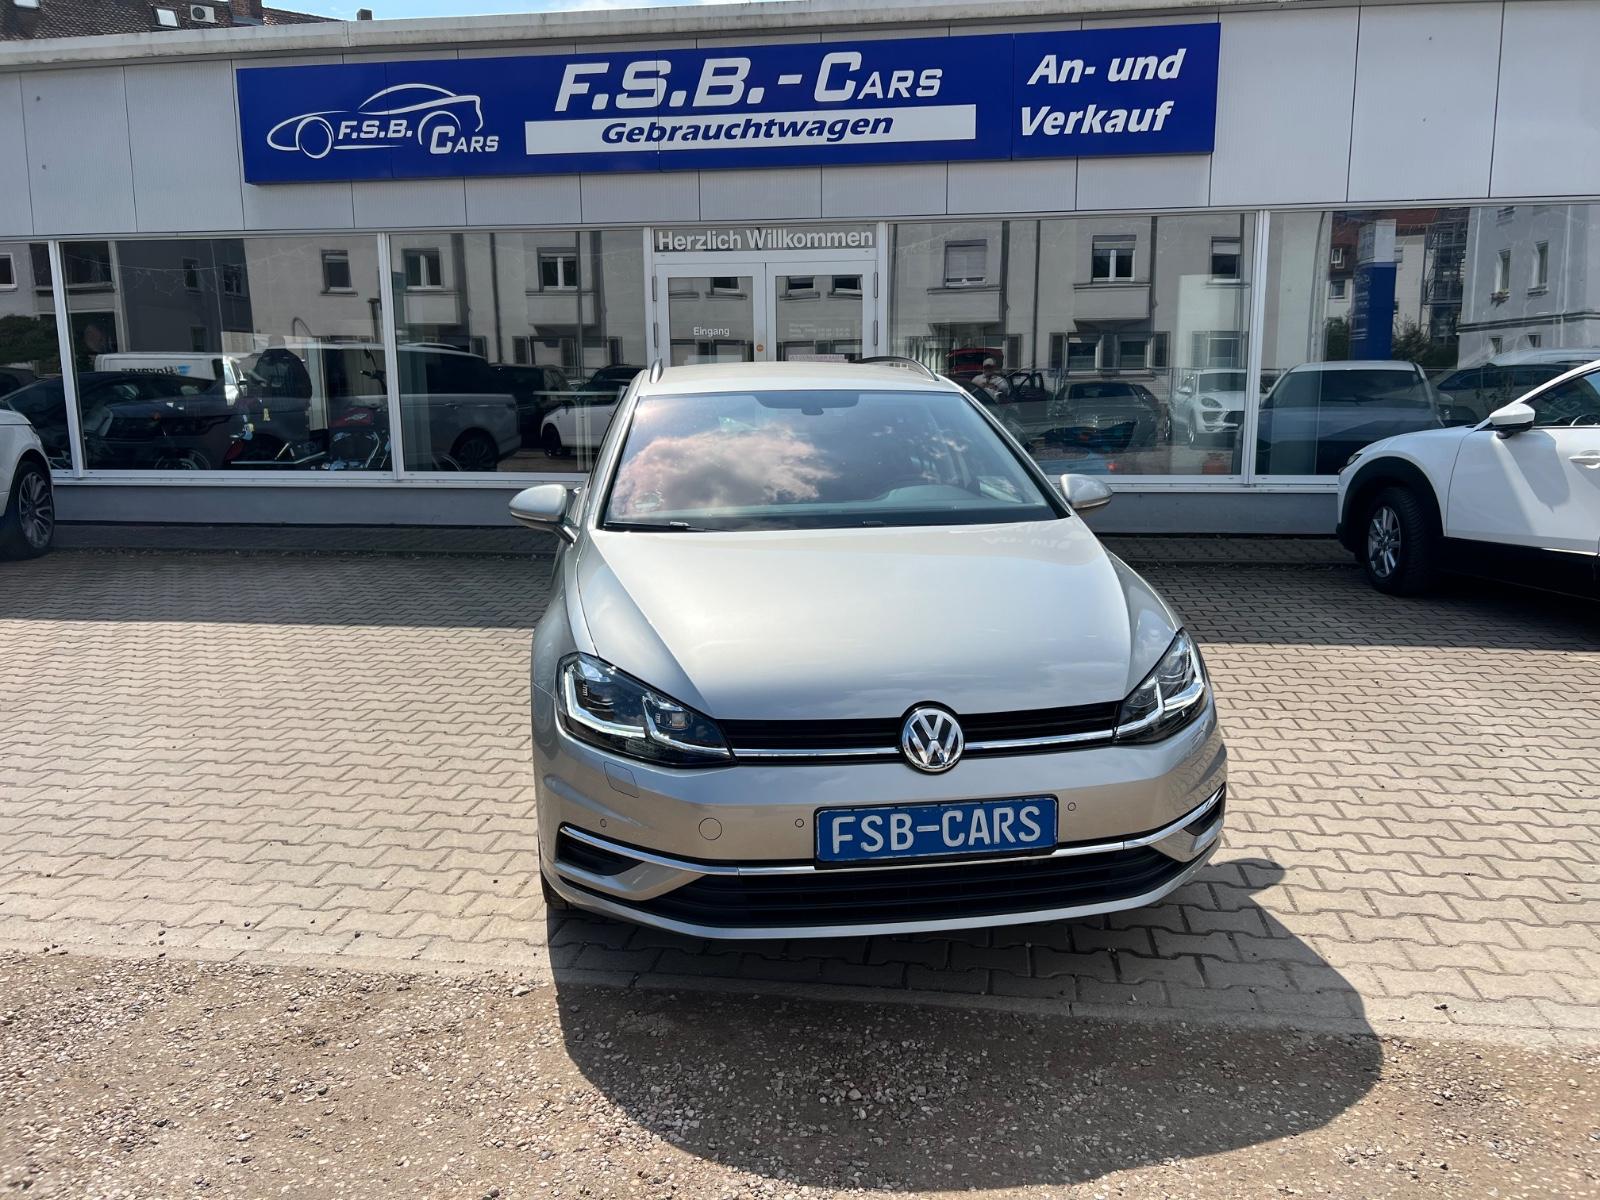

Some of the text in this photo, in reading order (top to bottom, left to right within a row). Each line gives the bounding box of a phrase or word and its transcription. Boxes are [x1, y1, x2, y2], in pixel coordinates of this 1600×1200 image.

[1026, 48, 1187, 85] An- und
[337, 119, 413, 140] F.S.B.
[600, 115, 894, 145] Gebrauchtwagen
[1021, 100, 1175, 136] Verkauf
[658, 229, 873, 250] Herzlich Willkommen
[693, 326, 730, 337] Eingang
[832, 806, 1041, 854] FSB-CARS
